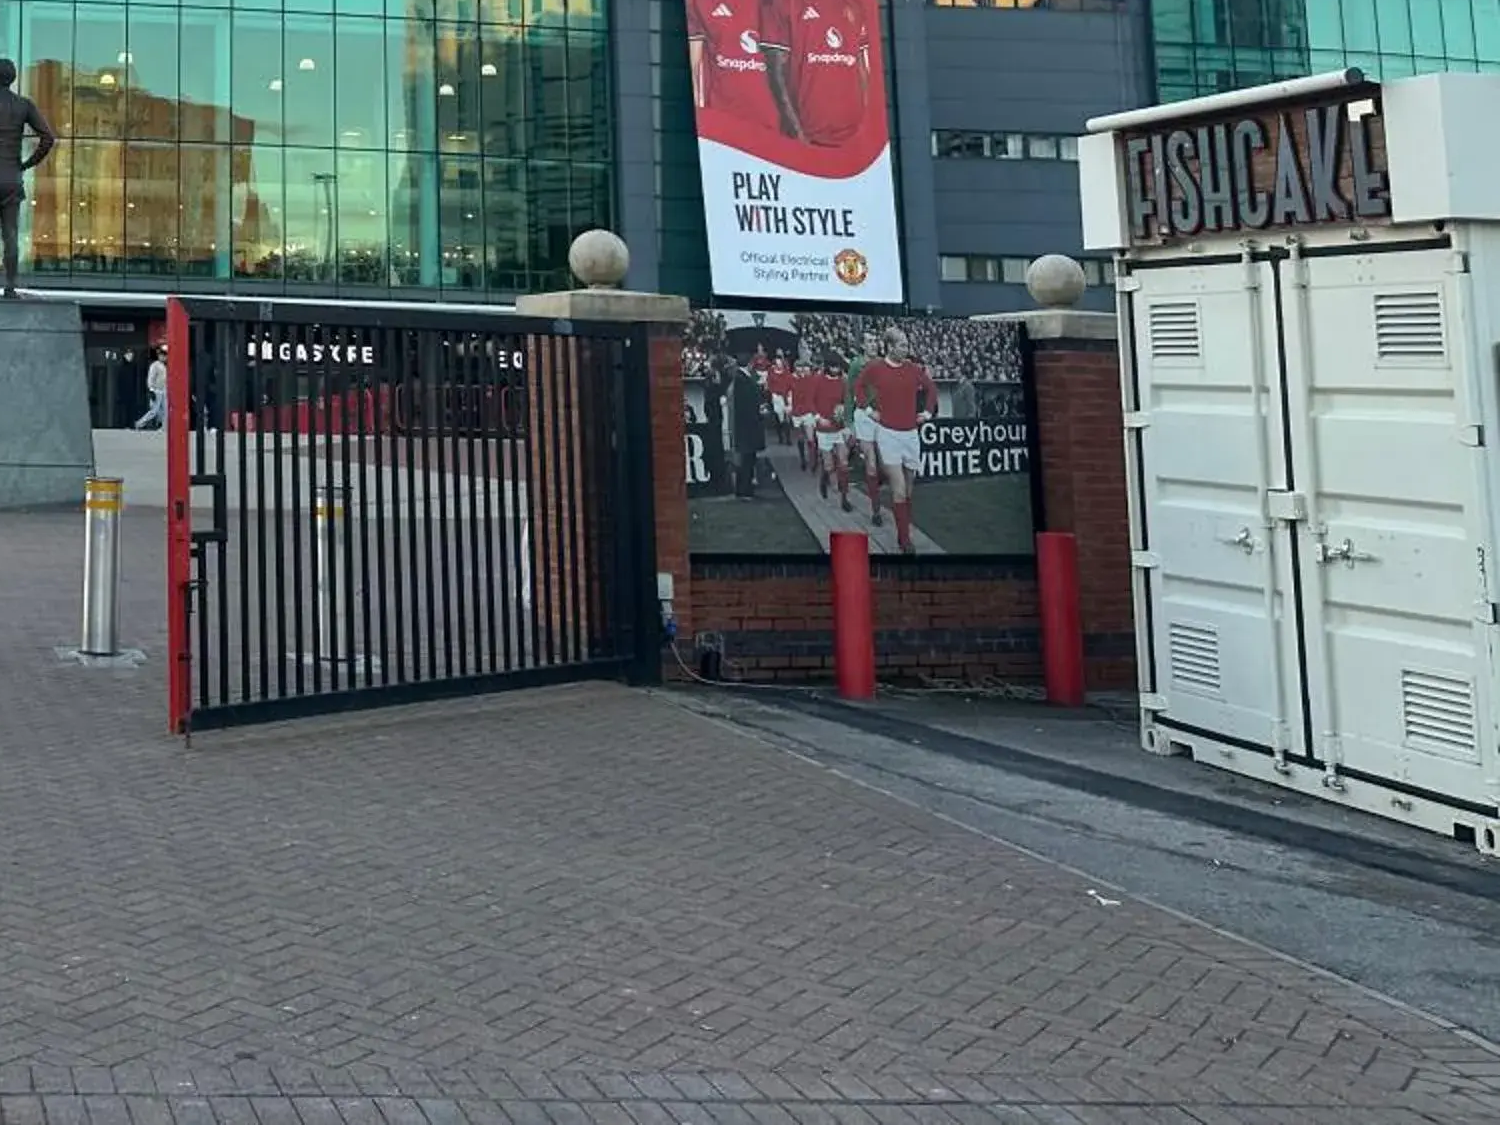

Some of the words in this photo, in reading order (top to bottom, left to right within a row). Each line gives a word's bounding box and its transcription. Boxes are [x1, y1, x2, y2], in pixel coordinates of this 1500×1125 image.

[733, 172, 781, 201] PLAY
[736, 204, 789, 234] WITH
[793, 207, 855, 237] STYLE
[780, 253, 829, 267] Electrical
[754, 267, 789, 282] Styling
